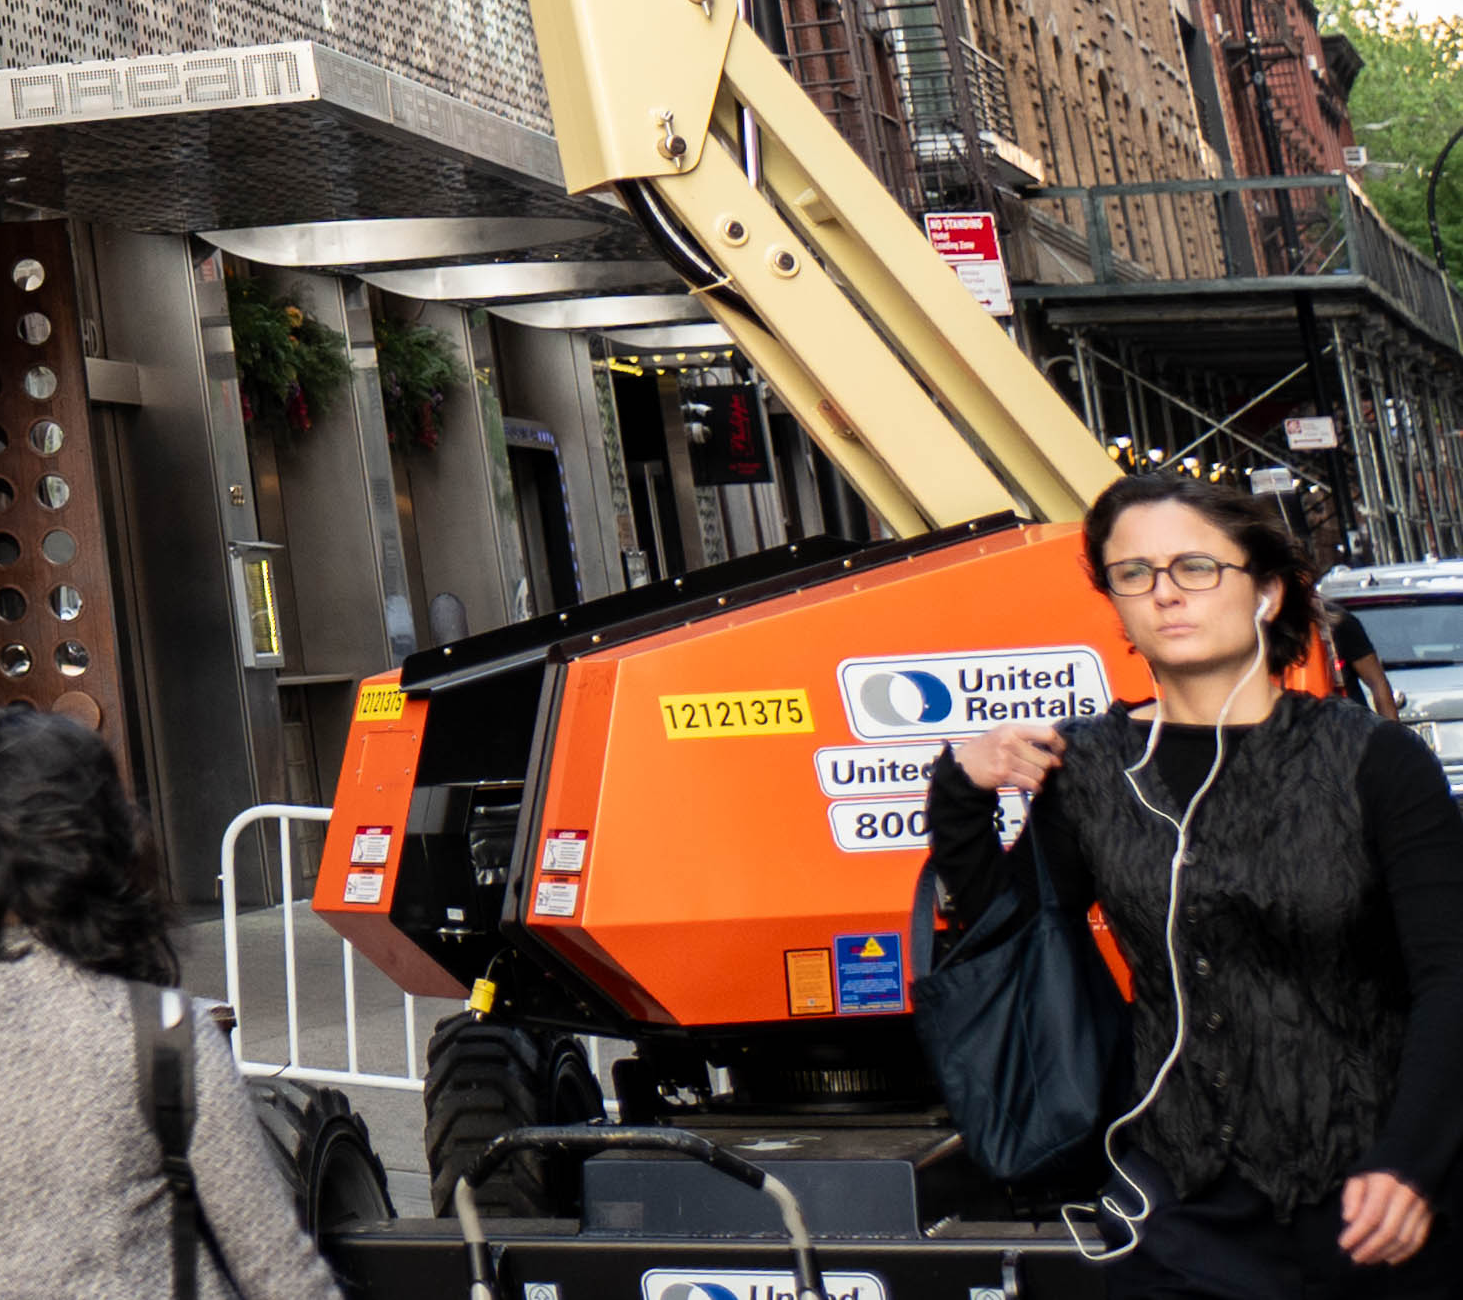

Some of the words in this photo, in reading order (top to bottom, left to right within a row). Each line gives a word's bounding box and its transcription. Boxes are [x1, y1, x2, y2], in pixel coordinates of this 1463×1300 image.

[929, 218, 941, 230] NO
[943, 218, 984, 230] STANDING
[959, 662, 1075, 694] United
[359, 689, 403, 714] 12121375
[664, 697, 805, 731] 12121375
[966, 691, 1096, 722] Rentals
